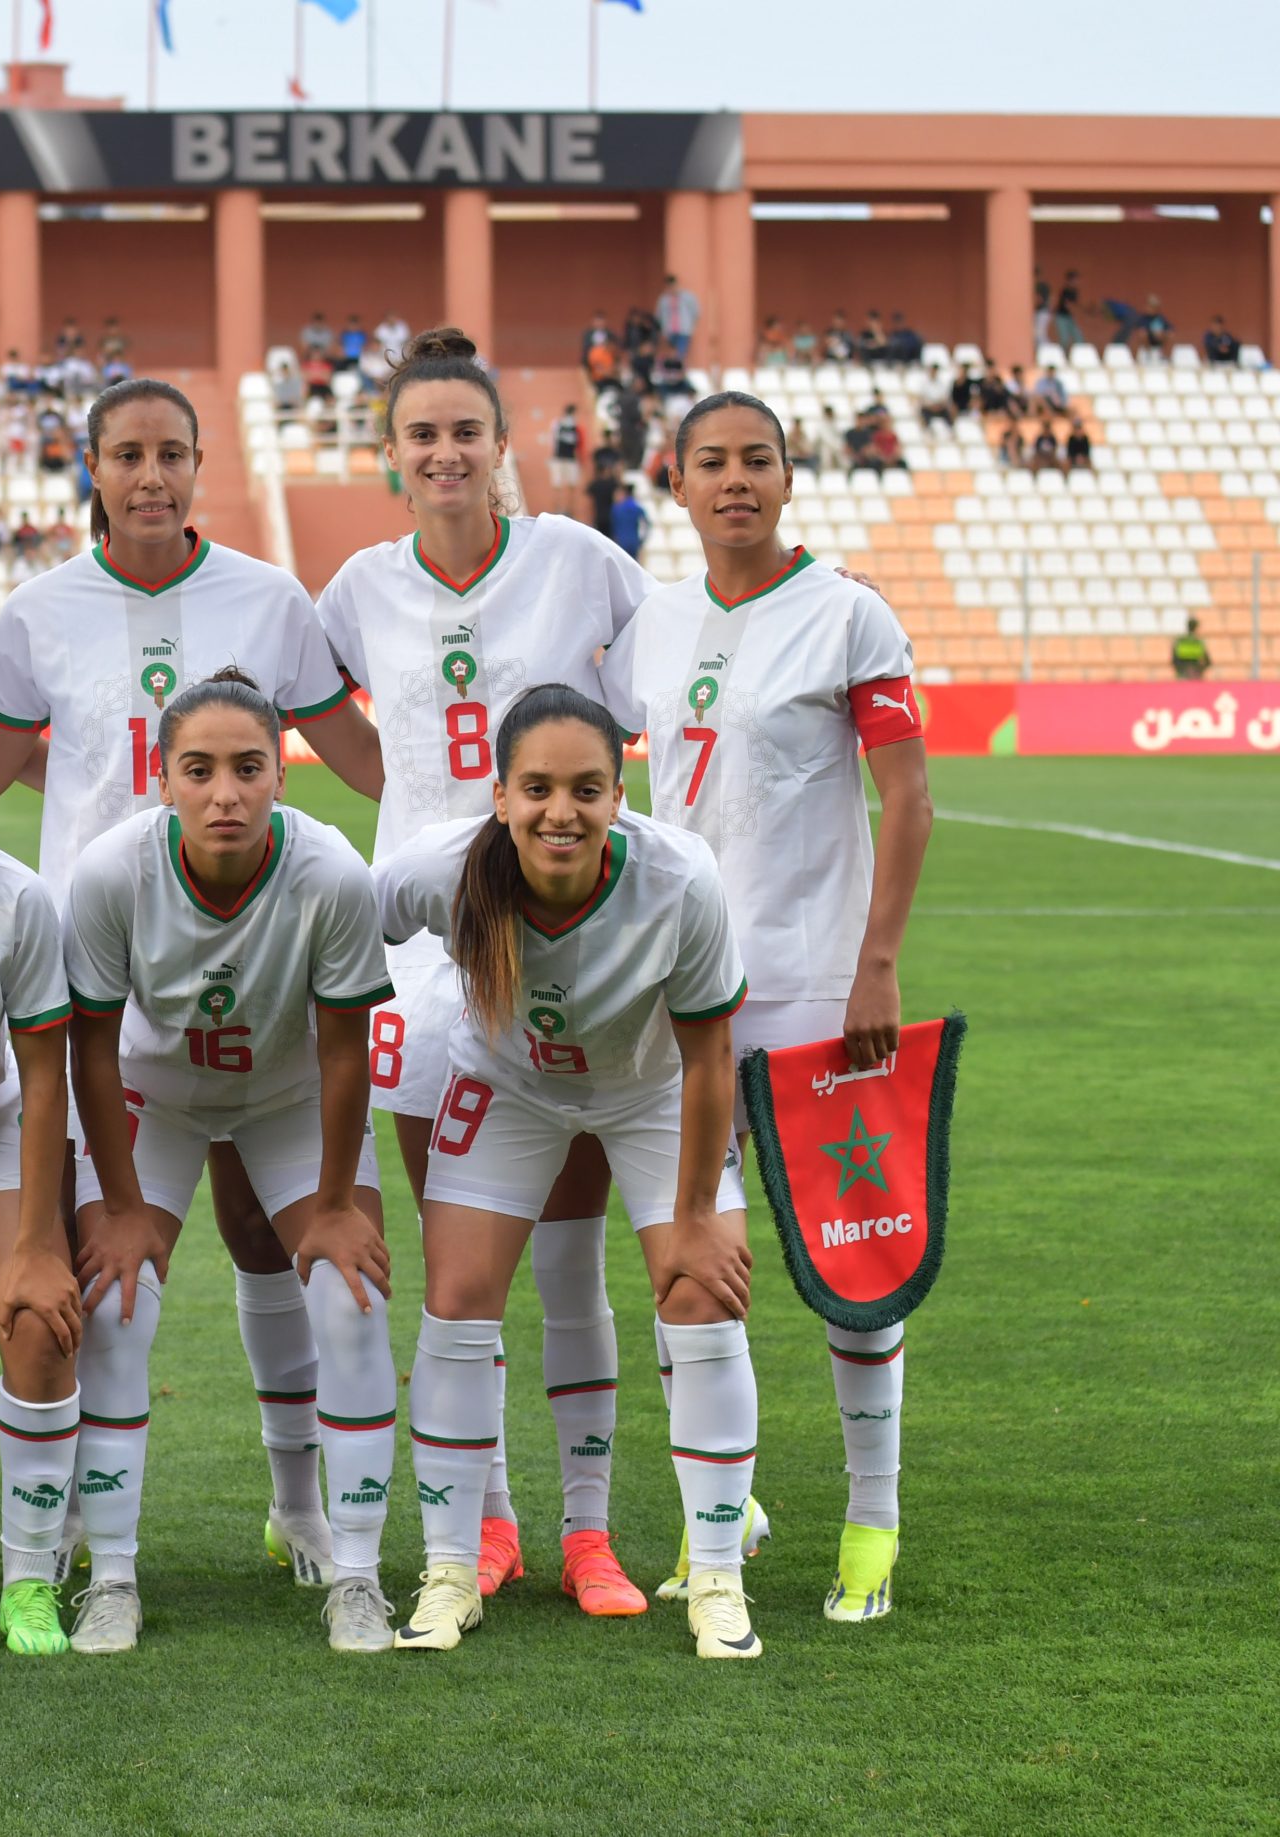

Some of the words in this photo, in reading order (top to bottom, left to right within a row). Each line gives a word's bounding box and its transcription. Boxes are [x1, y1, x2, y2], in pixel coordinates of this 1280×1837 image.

[172, 114, 604, 183] BERKANE
[442, 633, 470, 645] PUMA
[143, 646, 172, 657] PUMA
[698, 661, 724, 670] PUMA
[1131, 690, 1238, 751] ثمن
[445, 701, 493, 781] 8
[683, 728, 718, 806] 7
[203, 970, 233, 980] PUMA
[531, 989, 562, 1003] PUMA
[184, 1025, 253, 1073] 16
[371, 1010, 405, 1089] 8
[431, 1074, 494, 1157] 19
[821, 1213, 913, 1249] Maroc
[571, 1445, 608, 1456] PUMA
[78, 1481, 115, 1495] PUMA
[341, 1491, 382, 1503] PUMA
[12, 1486, 58, 1509] PUMA
[696, 1510, 739, 1523] PUMA
